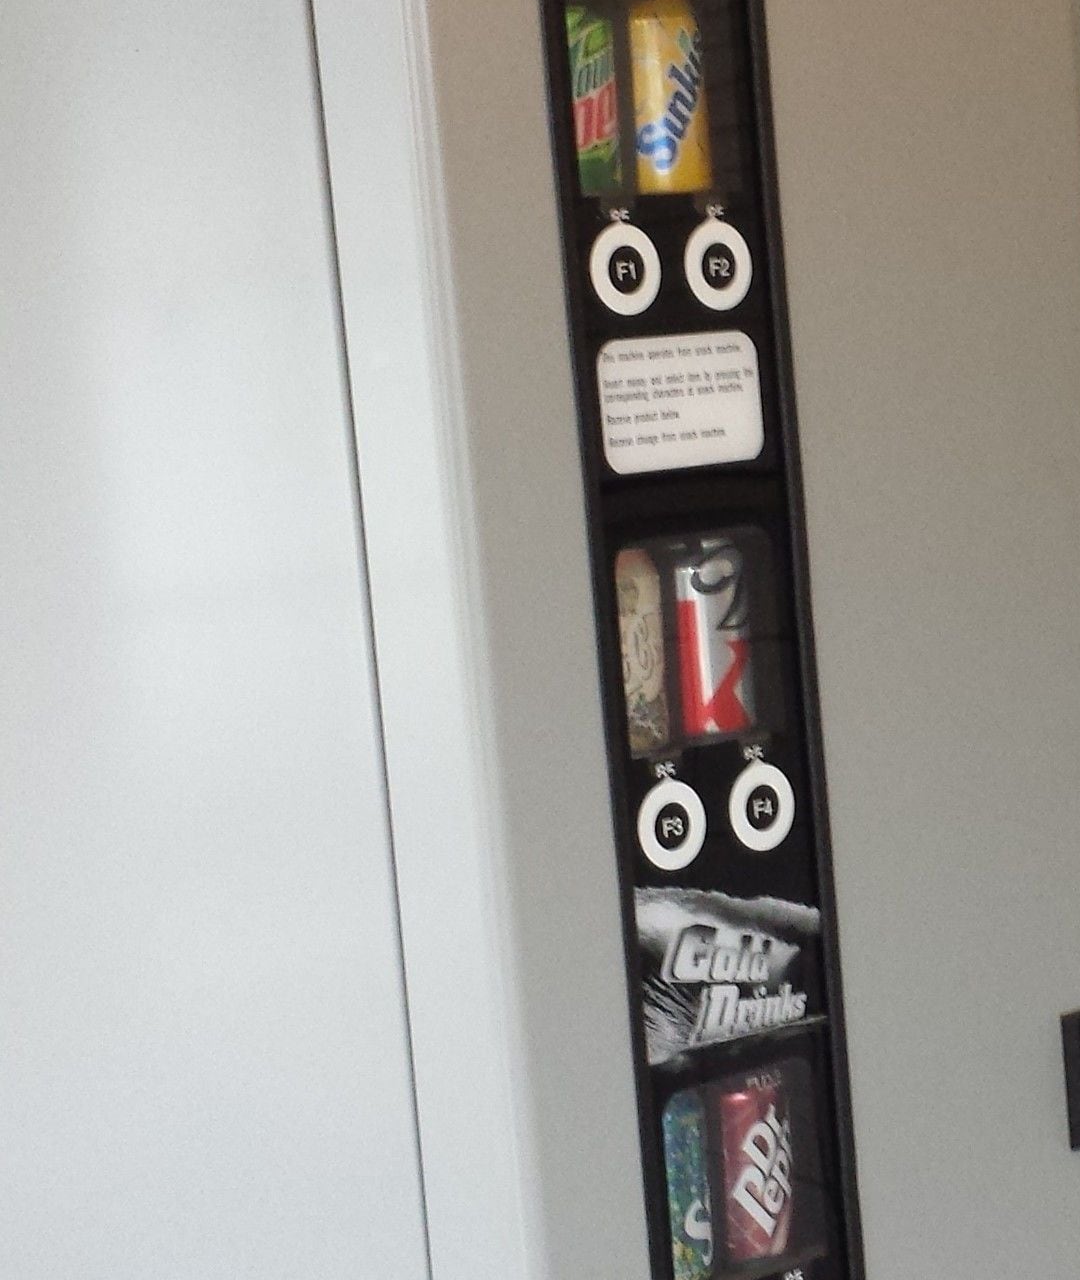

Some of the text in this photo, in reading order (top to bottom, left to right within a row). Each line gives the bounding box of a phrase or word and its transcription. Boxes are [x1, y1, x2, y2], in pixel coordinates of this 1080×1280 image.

[635, 26, 701, 173] Sunki
[615, 258, 637, 282] F1
[708, 255, 731, 278] F2
[752, 796, 773, 820] F4
[661, 815, 684, 838] F3
[662, 924, 772, 983] Cold
[694, 982, 808, 1042] Drinks
